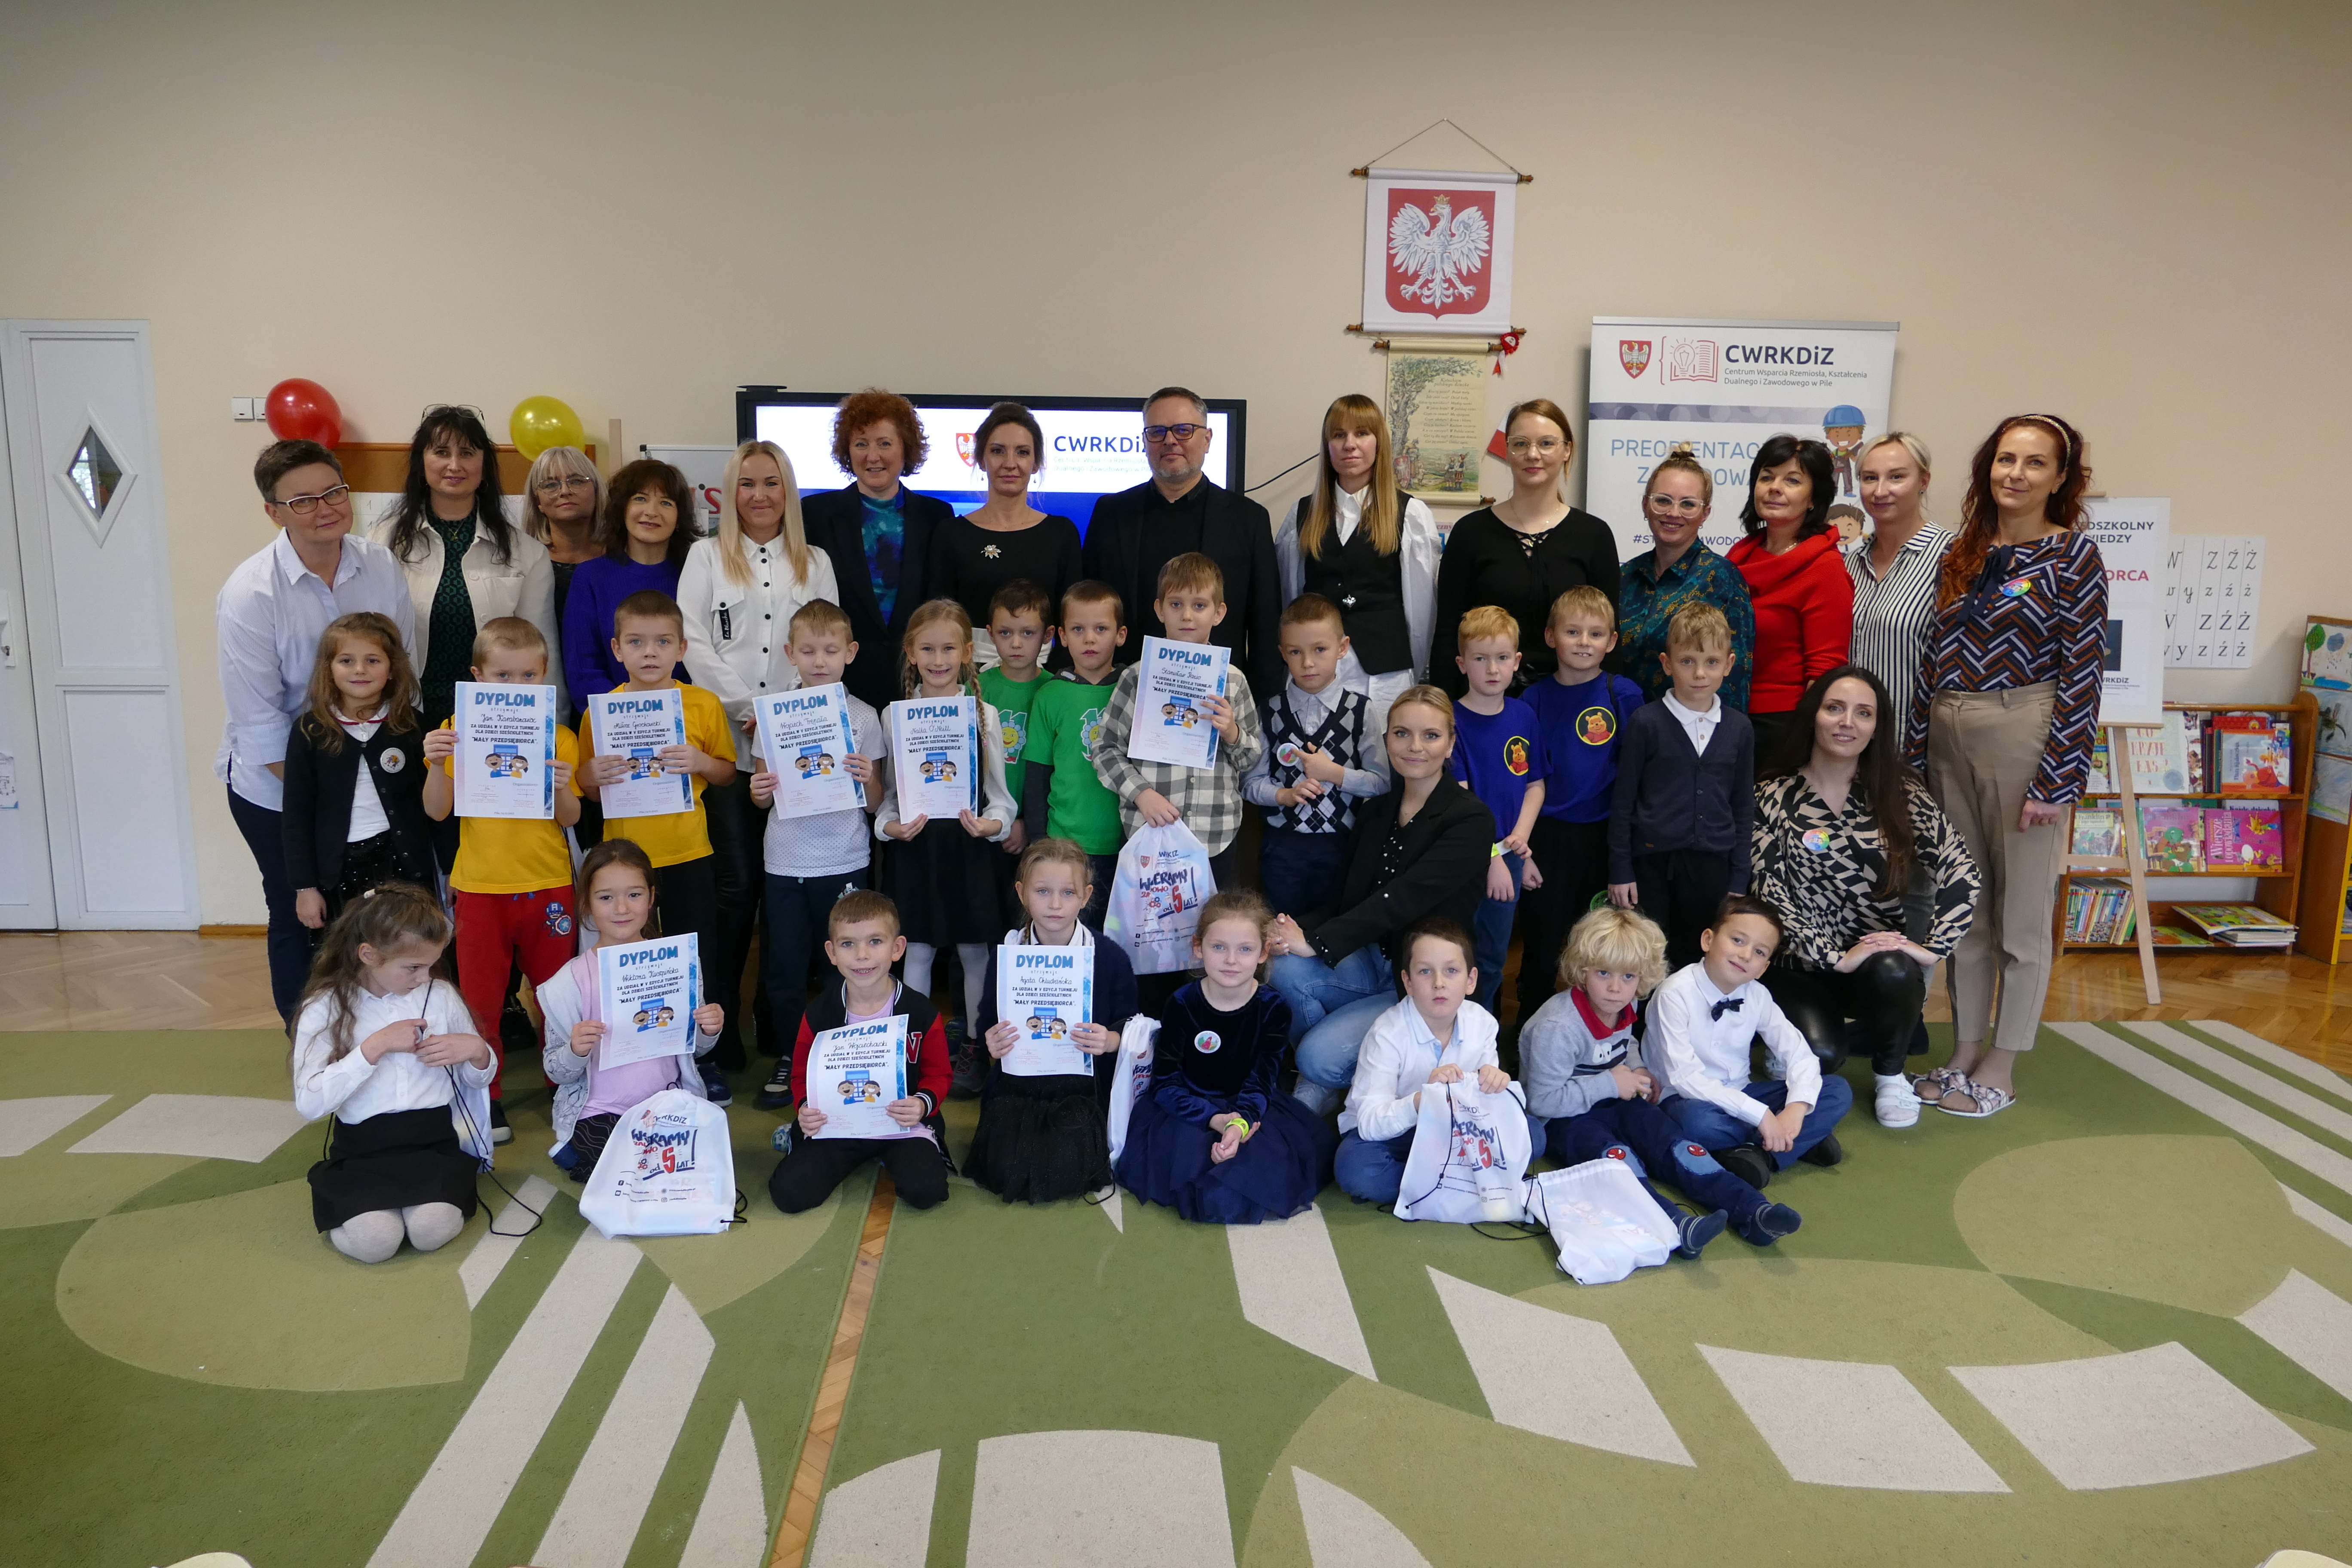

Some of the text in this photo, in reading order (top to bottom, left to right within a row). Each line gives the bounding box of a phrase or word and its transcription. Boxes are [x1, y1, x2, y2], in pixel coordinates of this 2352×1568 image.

[1725, 345, 1834, 365] CWRKDiZ
[1756, 369, 1788, 377] Wsparcia
[1763, 379, 1810, 387] Zawodowego
[1054, 436, 1146, 453] CWRKDi
[2089, 521, 2154, 530] DSZKOLNY
[2207, 549, 2257, 570] Z Ź Ż
[2106, 570, 2149, 581] ORCA
[2184, 583, 2251, 603] y z ź ż
[2199, 609, 2251, 630] Z Ź Ż
[1158, 647, 1212, 666] DYPLOM
[2176, 640, 2246, 661] y z ź ż
[475, 692, 535, 707] DYPLOM
[608, 699, 663, 714] DYPLOM
[773, 695, 828, 715] DYPLOM
[907, 705, 959, 720] DYPLOM
[2210, 818, 2223, 856] Wiersze
[1172, 885, 1182, 913] 5
[619, 946, 678, 967] DYPLOM
[1016, 955, 1073, 968] DYPLOM
[831, 1024, 888, 1040] DYPLOM
[662, 1146, 675, 1174] 5
[1479, 1138, 1492, 1169] 5
